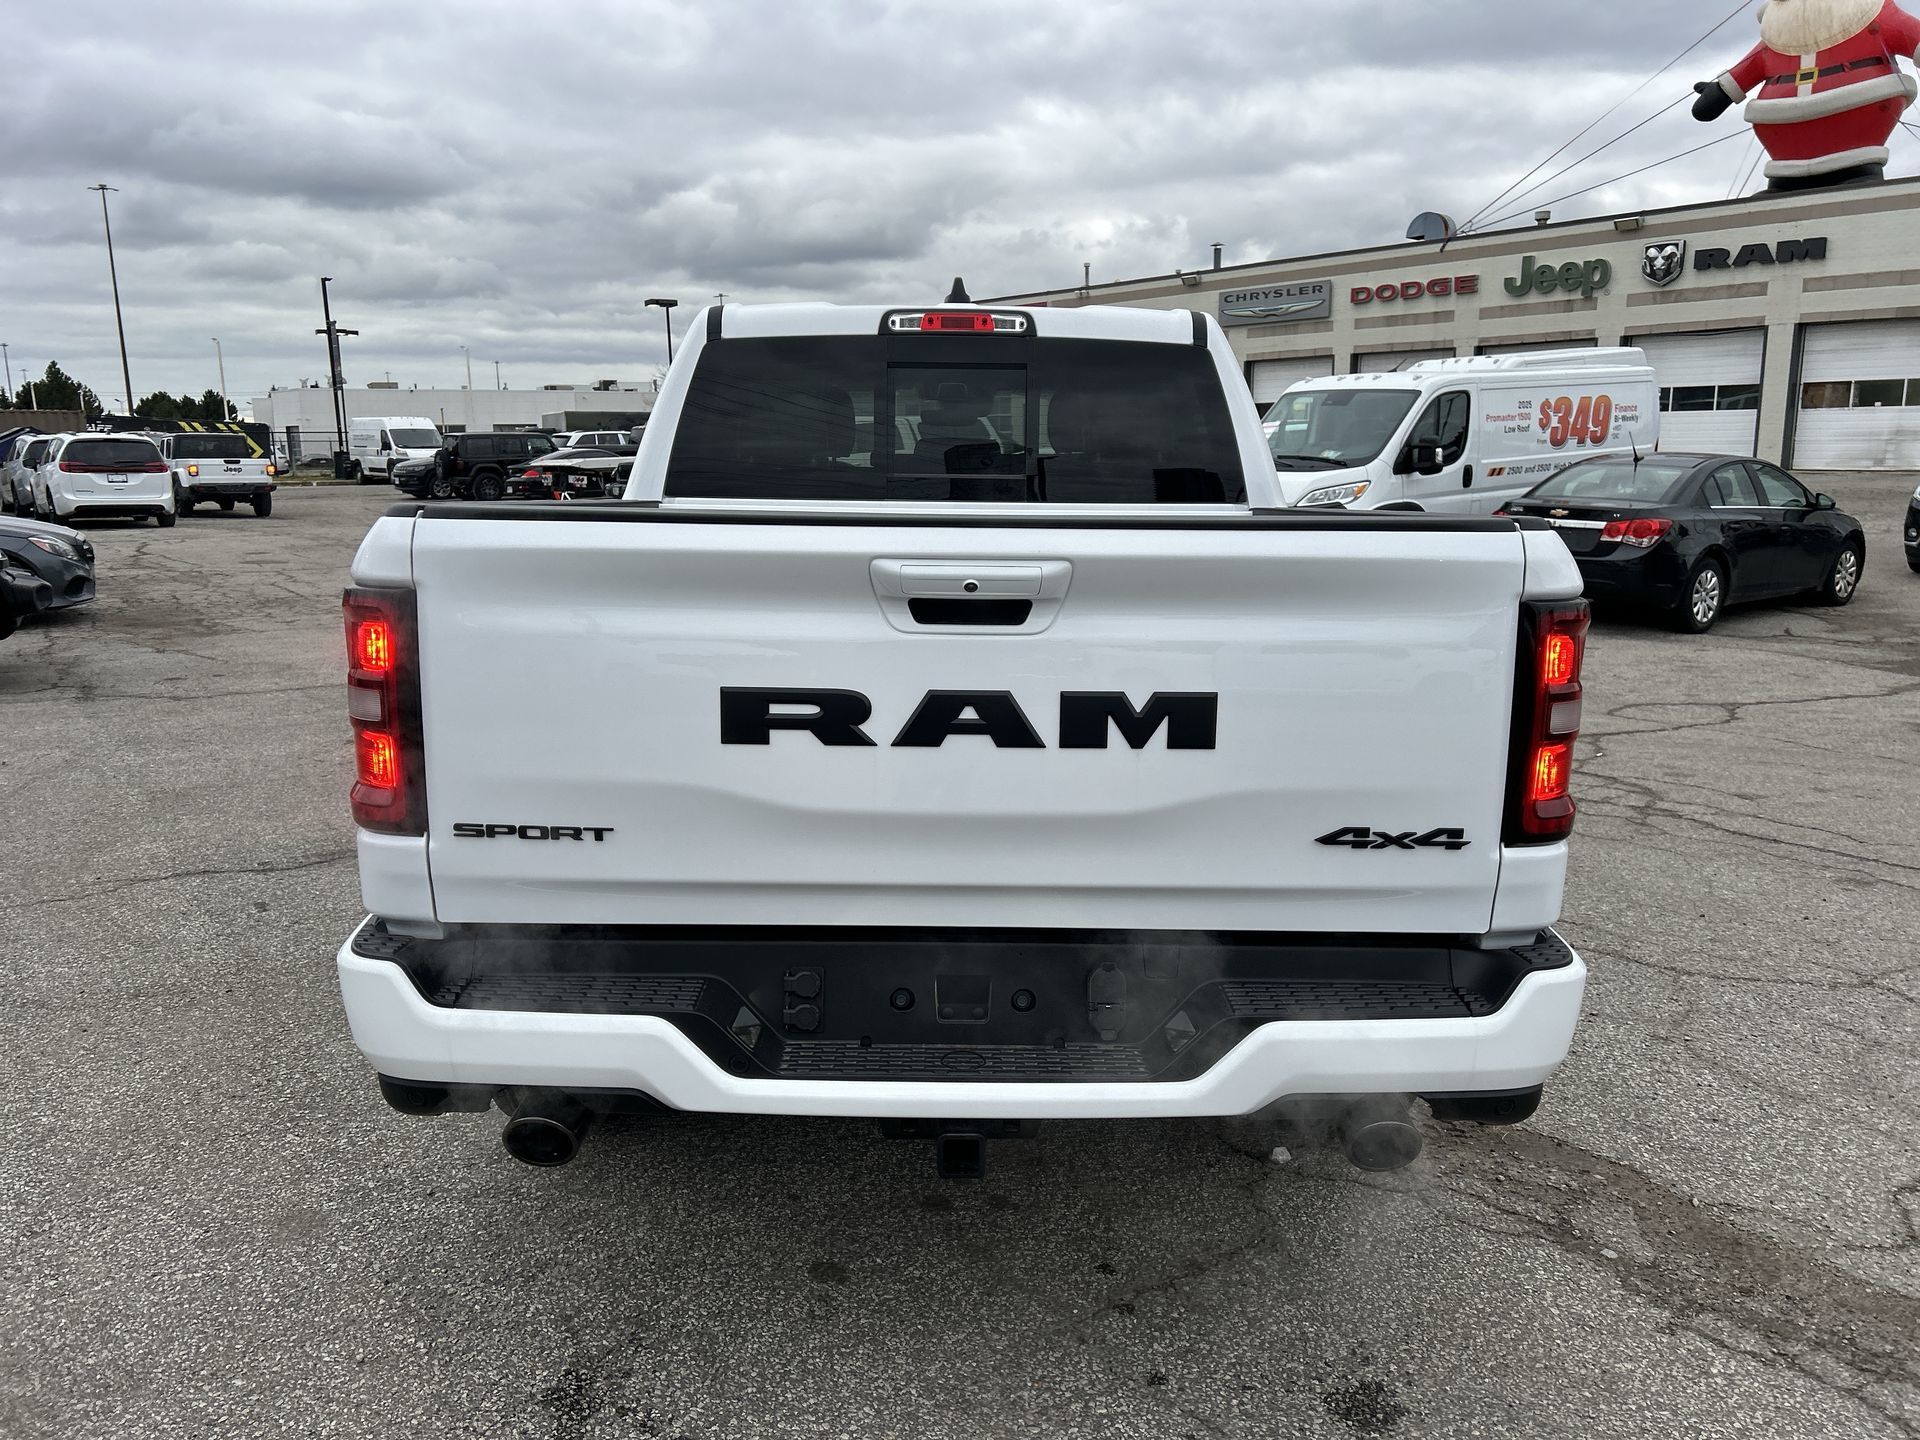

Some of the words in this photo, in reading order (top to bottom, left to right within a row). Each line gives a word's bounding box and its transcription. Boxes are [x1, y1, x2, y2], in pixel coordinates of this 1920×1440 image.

[1693, 236, 1828, 270] RAM
[1504, 255, 1611, 297] Jeep
[1223, 284, 1324, 304] CHRYSLER
[1350, 274, 1479, 304] DODGE
[1518, 400, 1532, 409] 2025
[1614, 403, 1638, 413] Finance
[1486, 414, 1517, 422] Promaster
[1517, 424, 1530, 432] Roof
[1538, 394, 1612, 449] $349
[1507, 466, 1522, 475] 2500
[1524, 465, 1536, 474] and
[720, 686, 1218, 750] RAM
[453, 823, 614, 842] SPORT
[1313, 827, 1472, 850] 4x4
